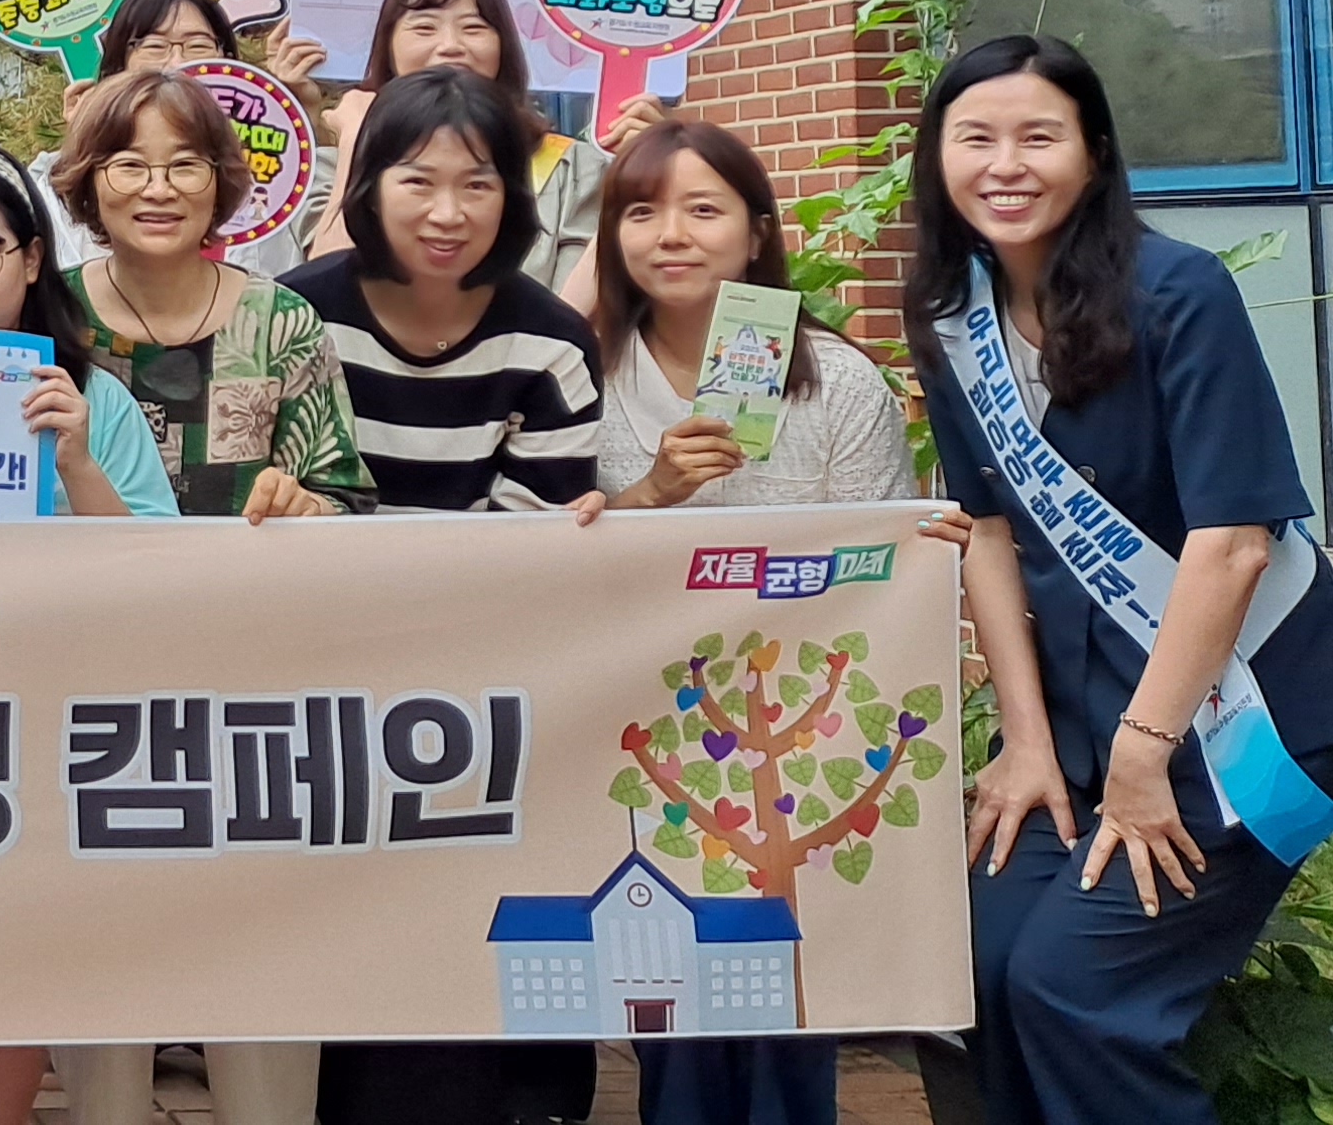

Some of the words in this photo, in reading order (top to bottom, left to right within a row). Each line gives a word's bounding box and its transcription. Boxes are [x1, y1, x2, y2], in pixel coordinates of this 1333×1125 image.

[695, 552, 757, 584] 자율
[765, 560, 829, 593] 균형
[835, 548, 890, 581] 미래
[66, 693, 525, 851] 캠페인
